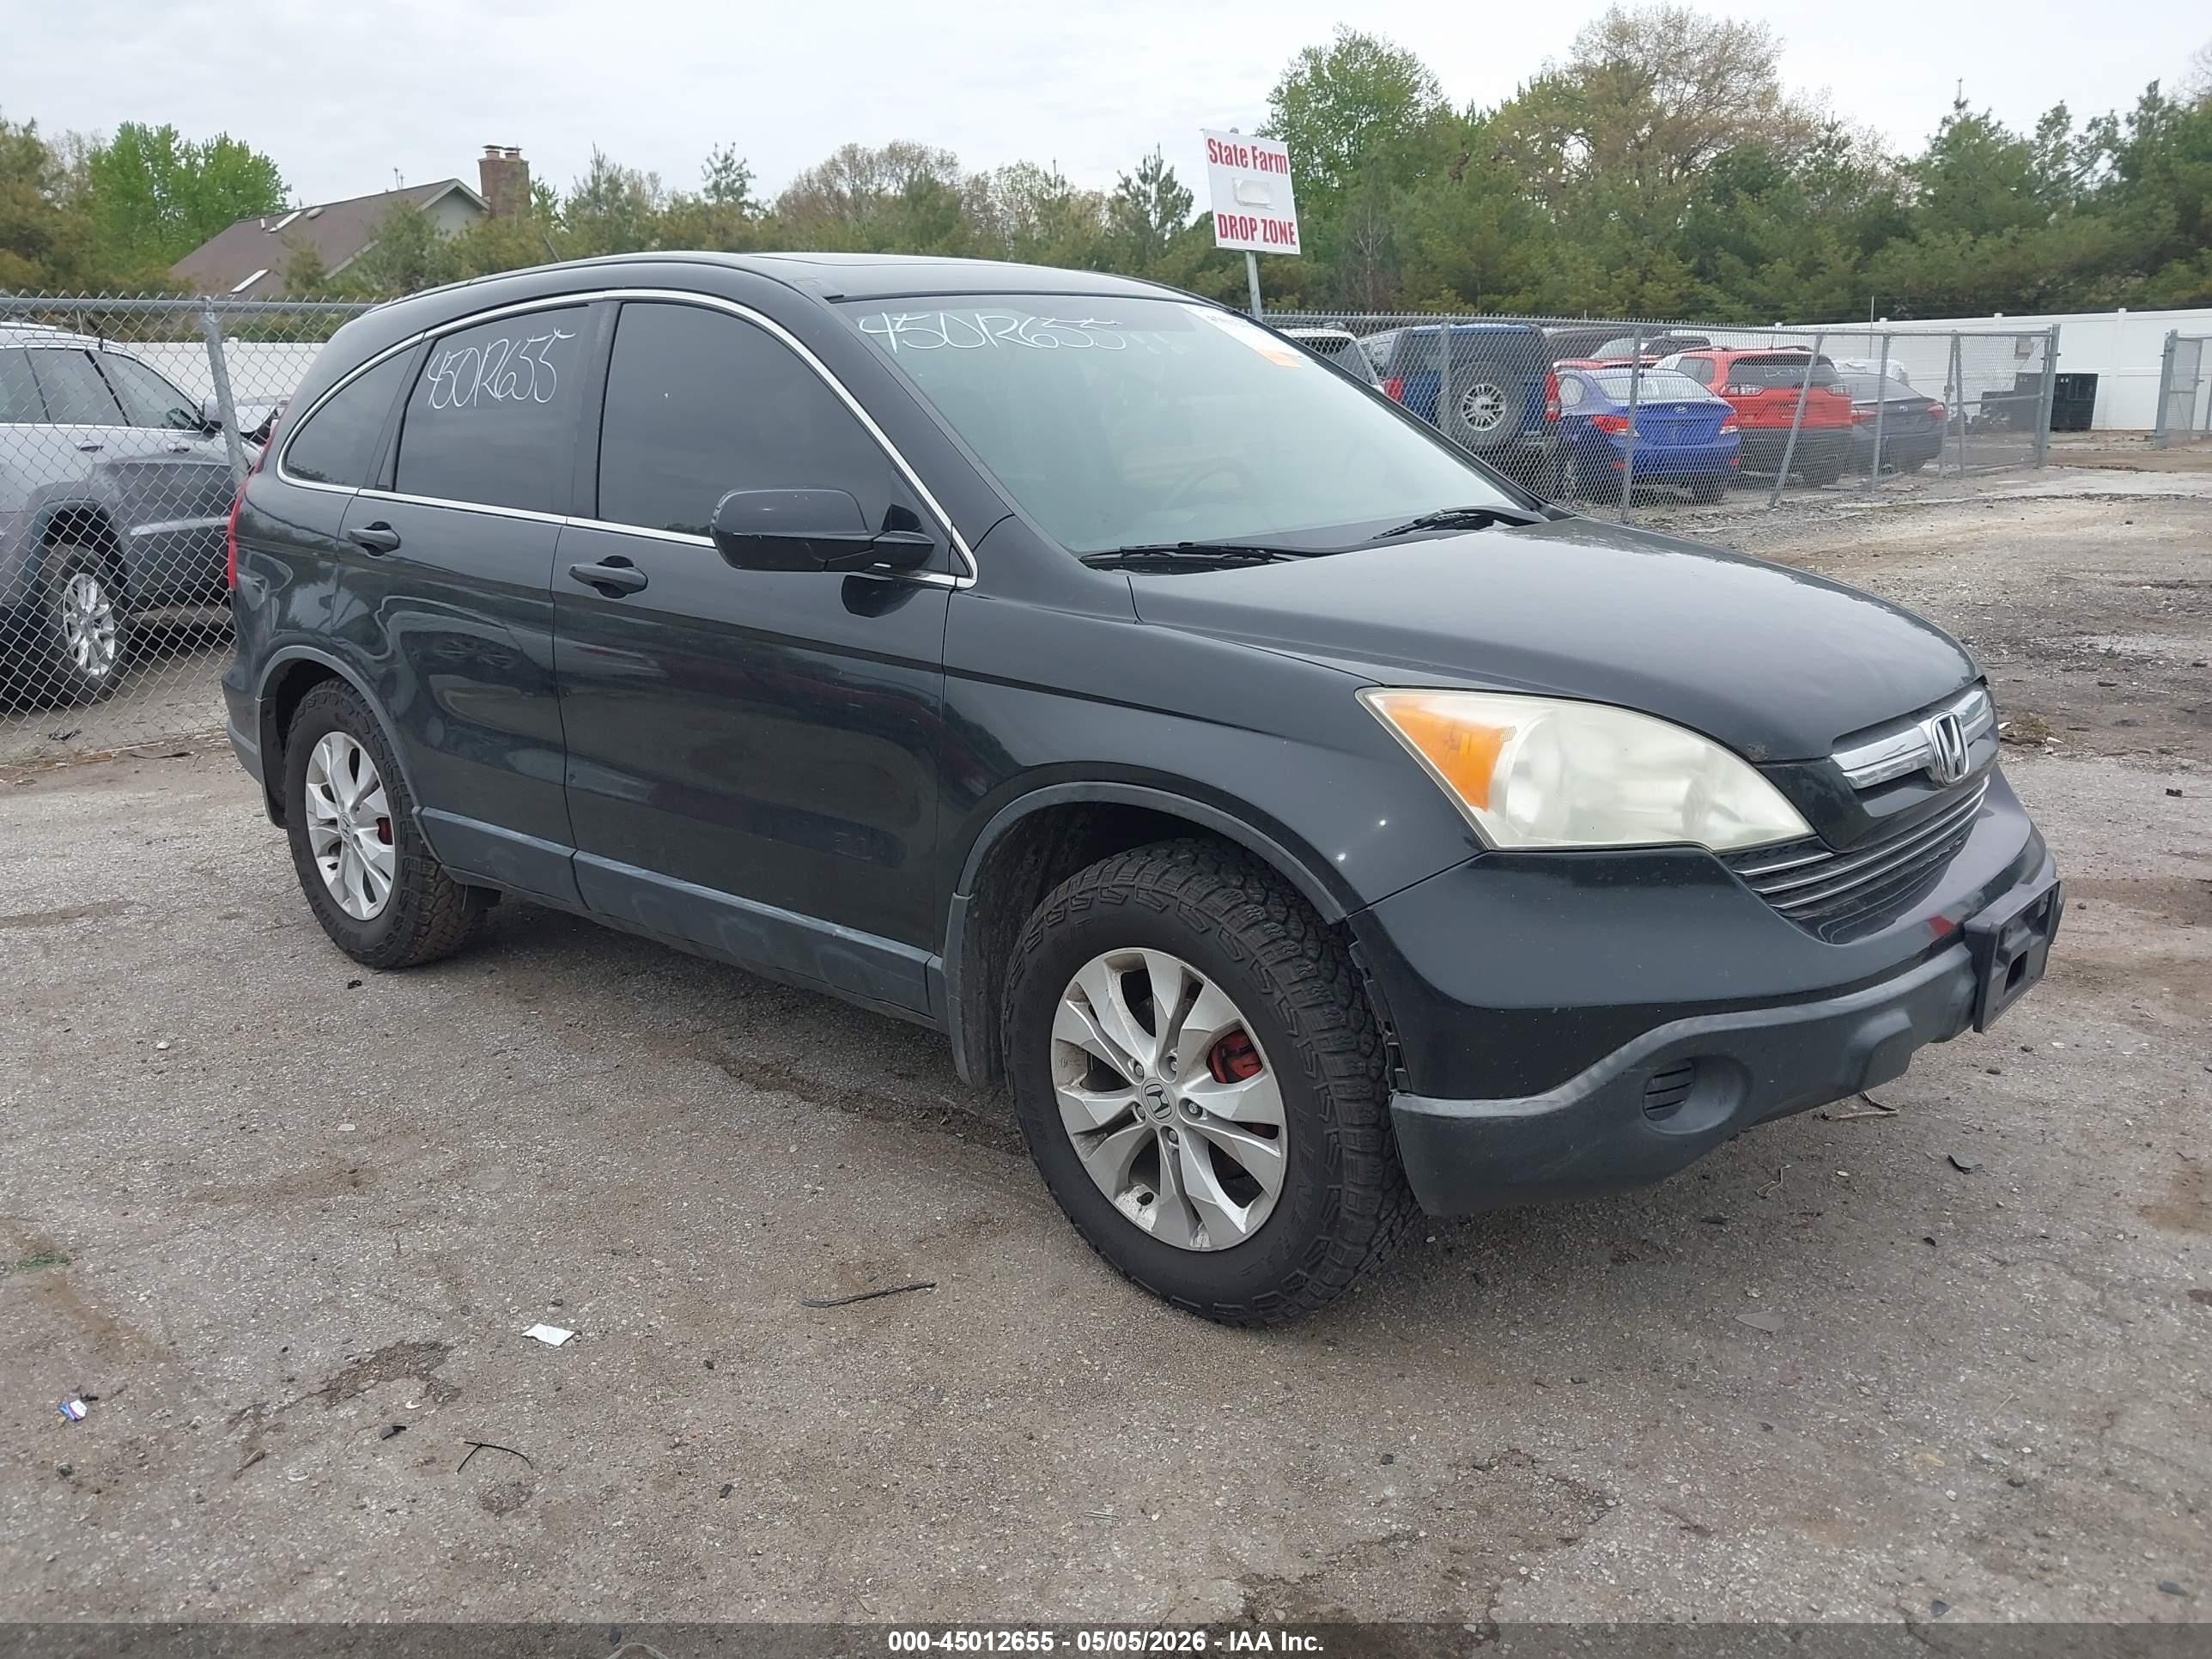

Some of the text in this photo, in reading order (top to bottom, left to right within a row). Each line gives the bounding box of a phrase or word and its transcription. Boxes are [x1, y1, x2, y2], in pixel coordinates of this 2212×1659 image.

[1207, 138, 1288, 174] State Farm
[1218, 214, 1297, 246] DROP ZONE
